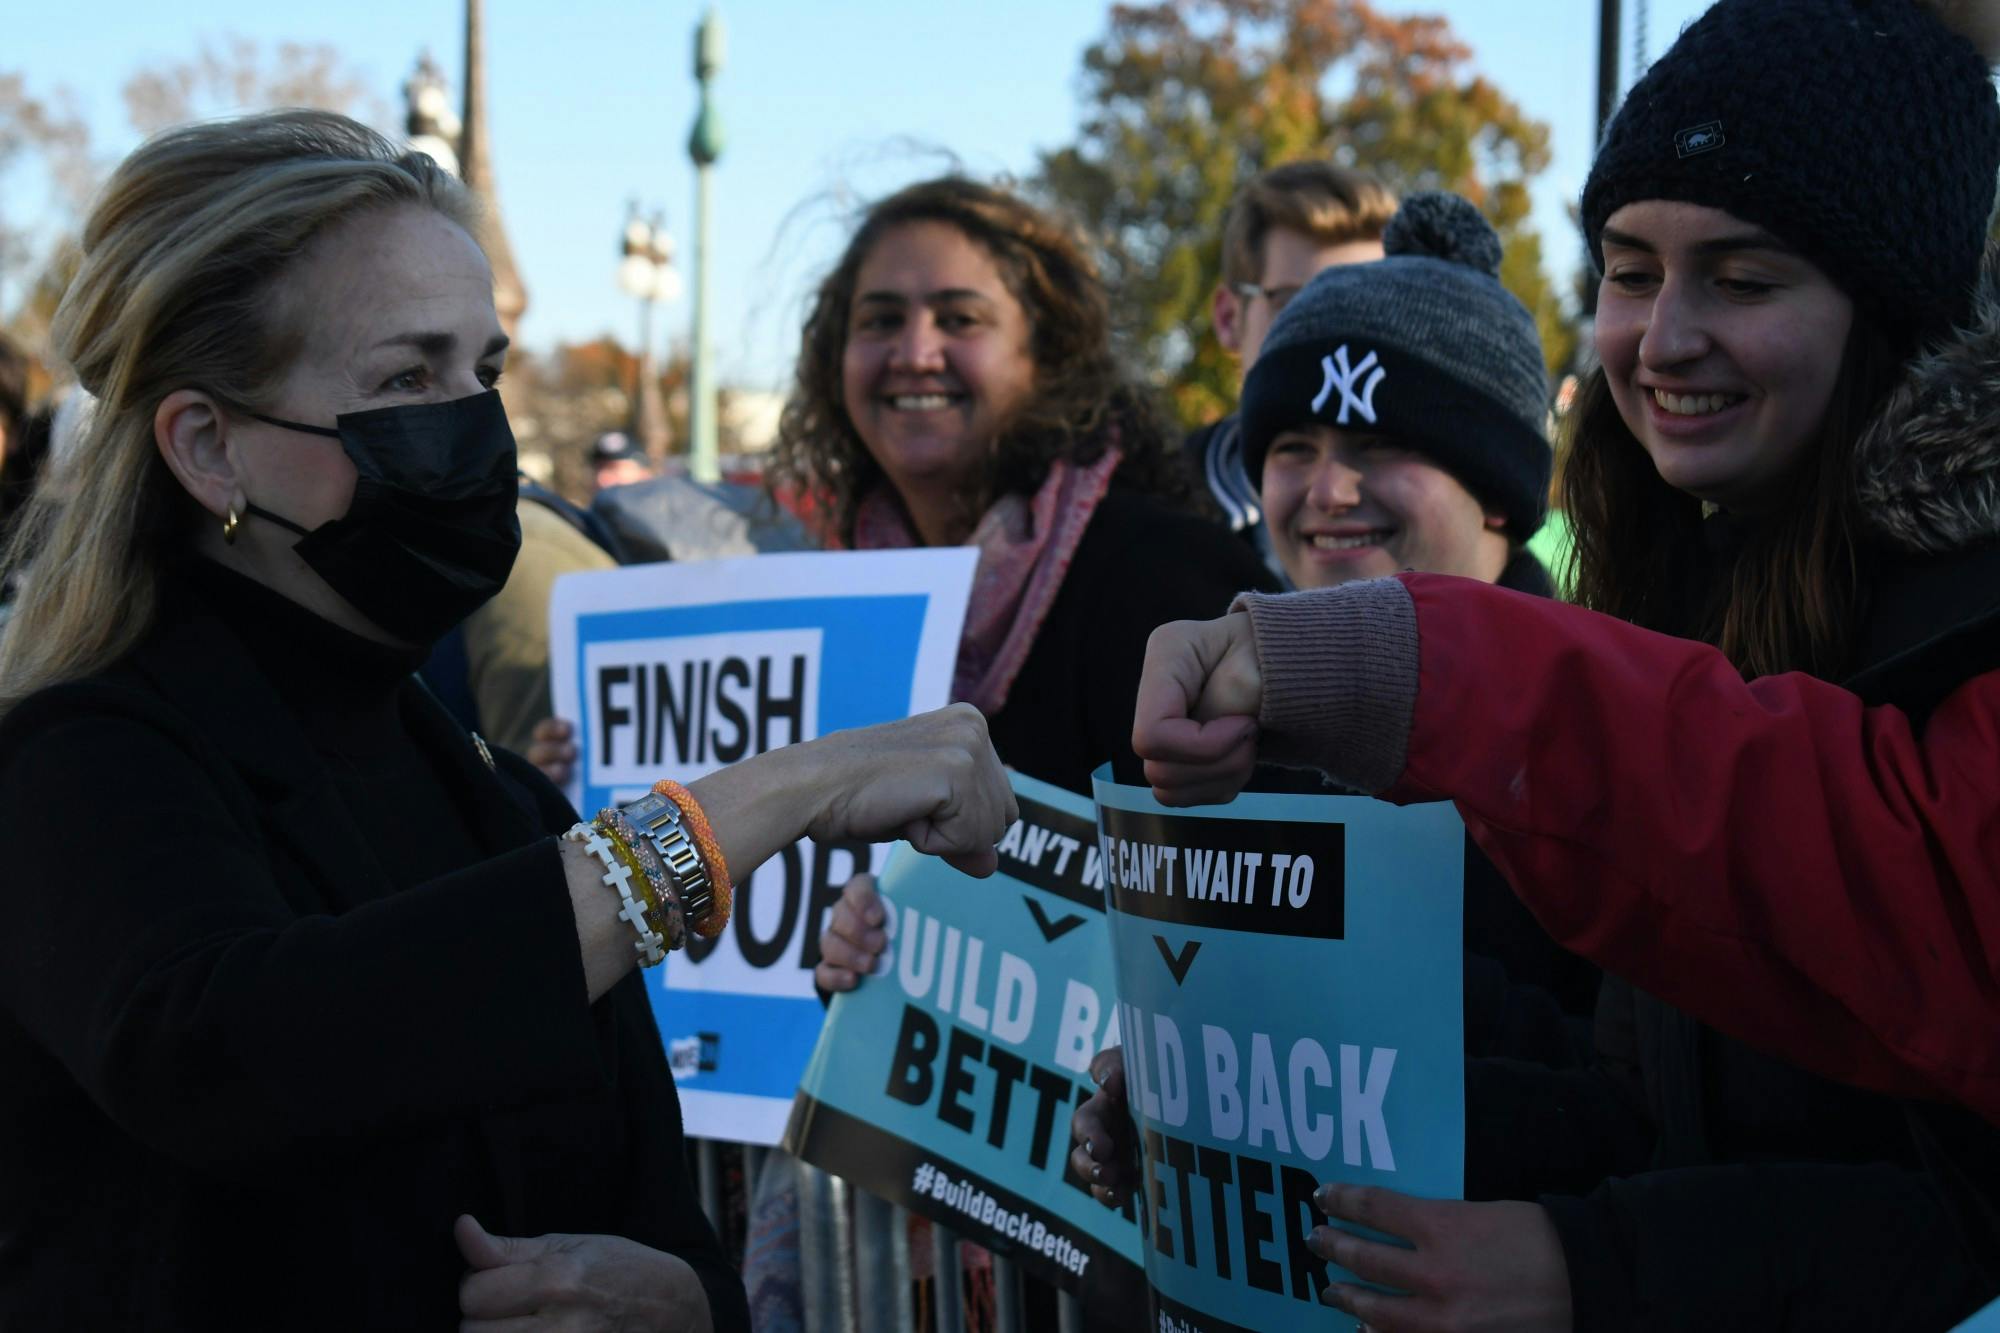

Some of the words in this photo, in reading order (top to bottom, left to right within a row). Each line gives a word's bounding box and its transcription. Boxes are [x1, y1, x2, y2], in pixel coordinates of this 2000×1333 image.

[1311, 344, 1386, 424] NY
[598, 655, 807, 767] FINISH
[686, 836, 871, 968] OB
[992, 819, 1080, 876] AN'T
[1119, 838, 1178, 897] CAN'T
[1184, 847, 1263, 905] WAIT
[1271, 853, 1315, 909] TO
[885, 1003, 1137, 1225] BETT
[1119, 1001, 1189, 1128] ILD
[1201, 1023, 1398, 1172] BACK
[912, 1162, 1090, 1277] #BuildBackBetter
[1143, 1127, 1330, 1306] ETTER
